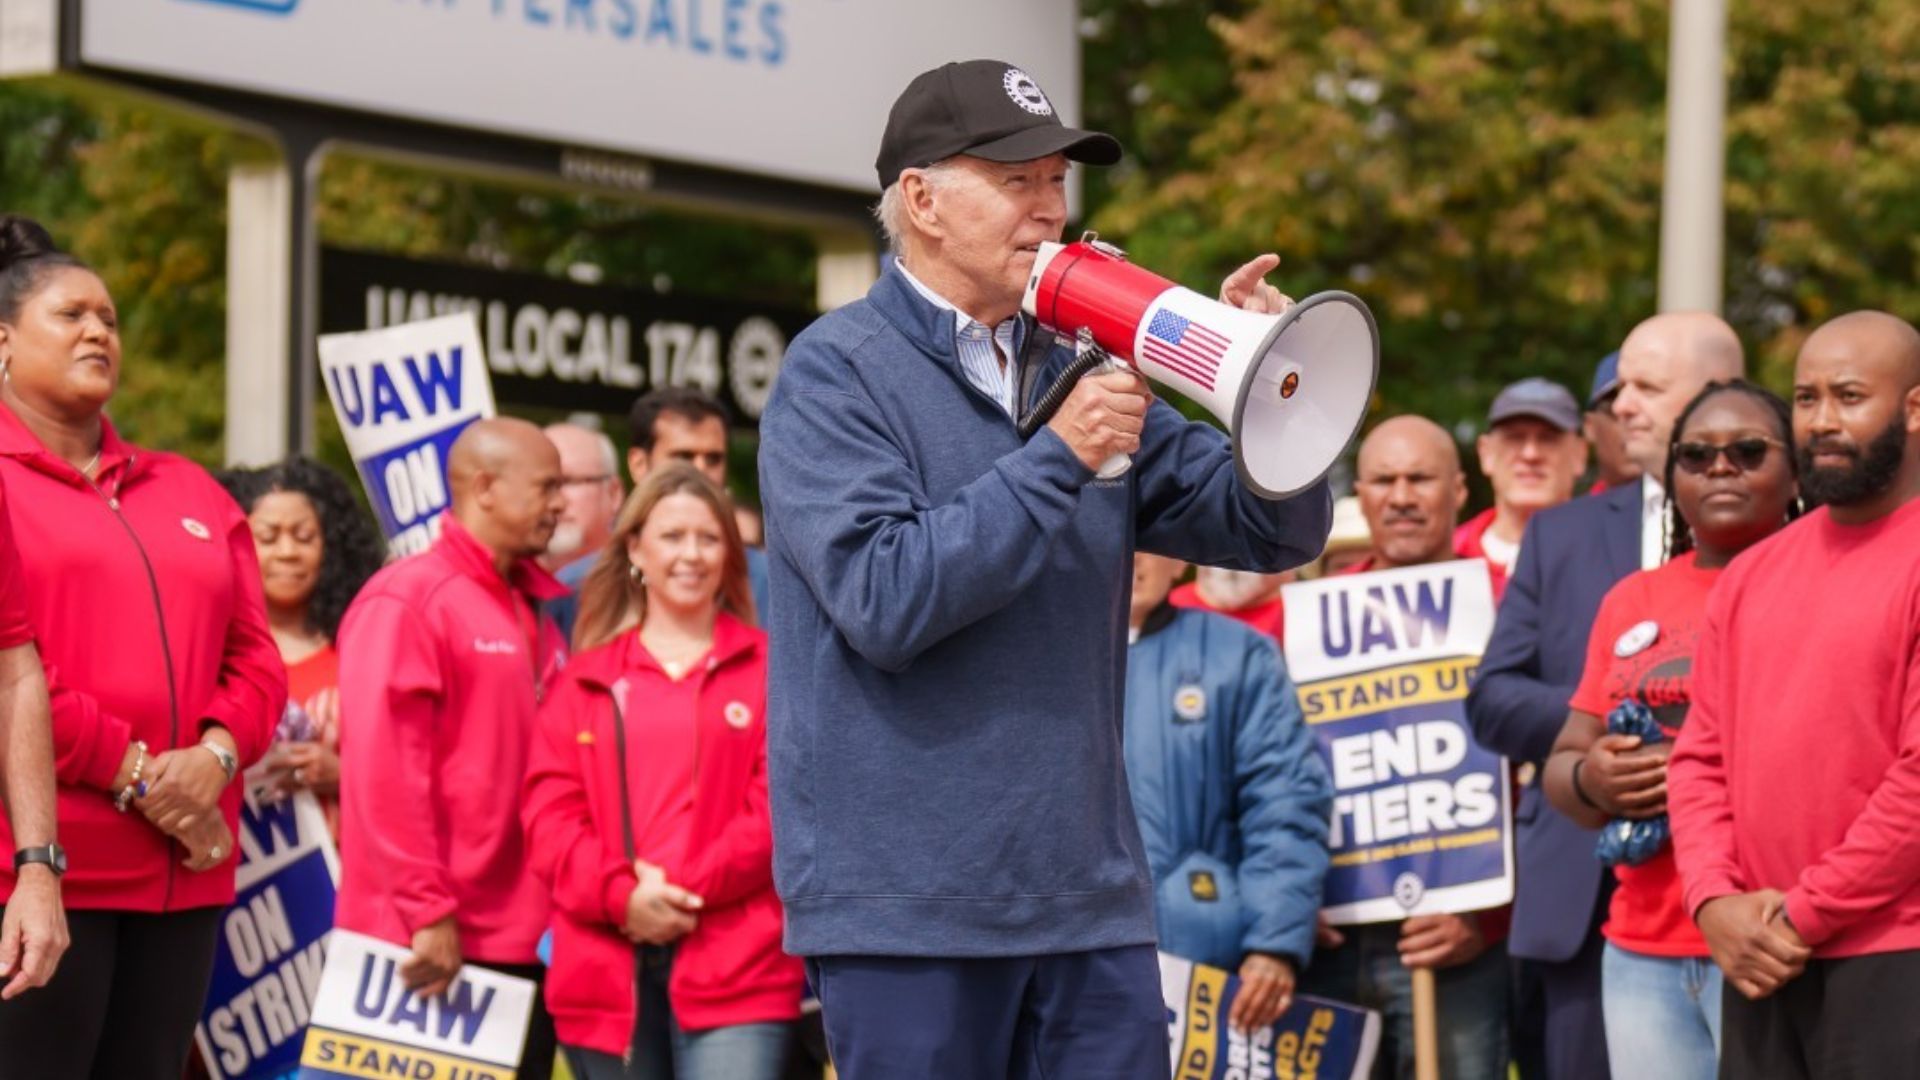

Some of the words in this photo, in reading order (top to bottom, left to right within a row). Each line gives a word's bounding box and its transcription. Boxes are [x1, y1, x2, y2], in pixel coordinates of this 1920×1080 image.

[328, 345, 464, 428] UAW
[488, 302, 645, 388] LOCAL
[646, 322, 720, 396] 174
[385, 444, 446, 524] ON
[1319, 577, 1455, 659] UAW
[1305, 674, 1422, 717] STAND
[1333, 720, 1467, 788] END
[1330, 772, 1498, 847] TIERS
[225, 885, 293, 978] ON
[208, 934, 330, 1076] STRIK
[352, 953, 497, 1046] UAW
[317, 1039, 437, 1080] STAND
